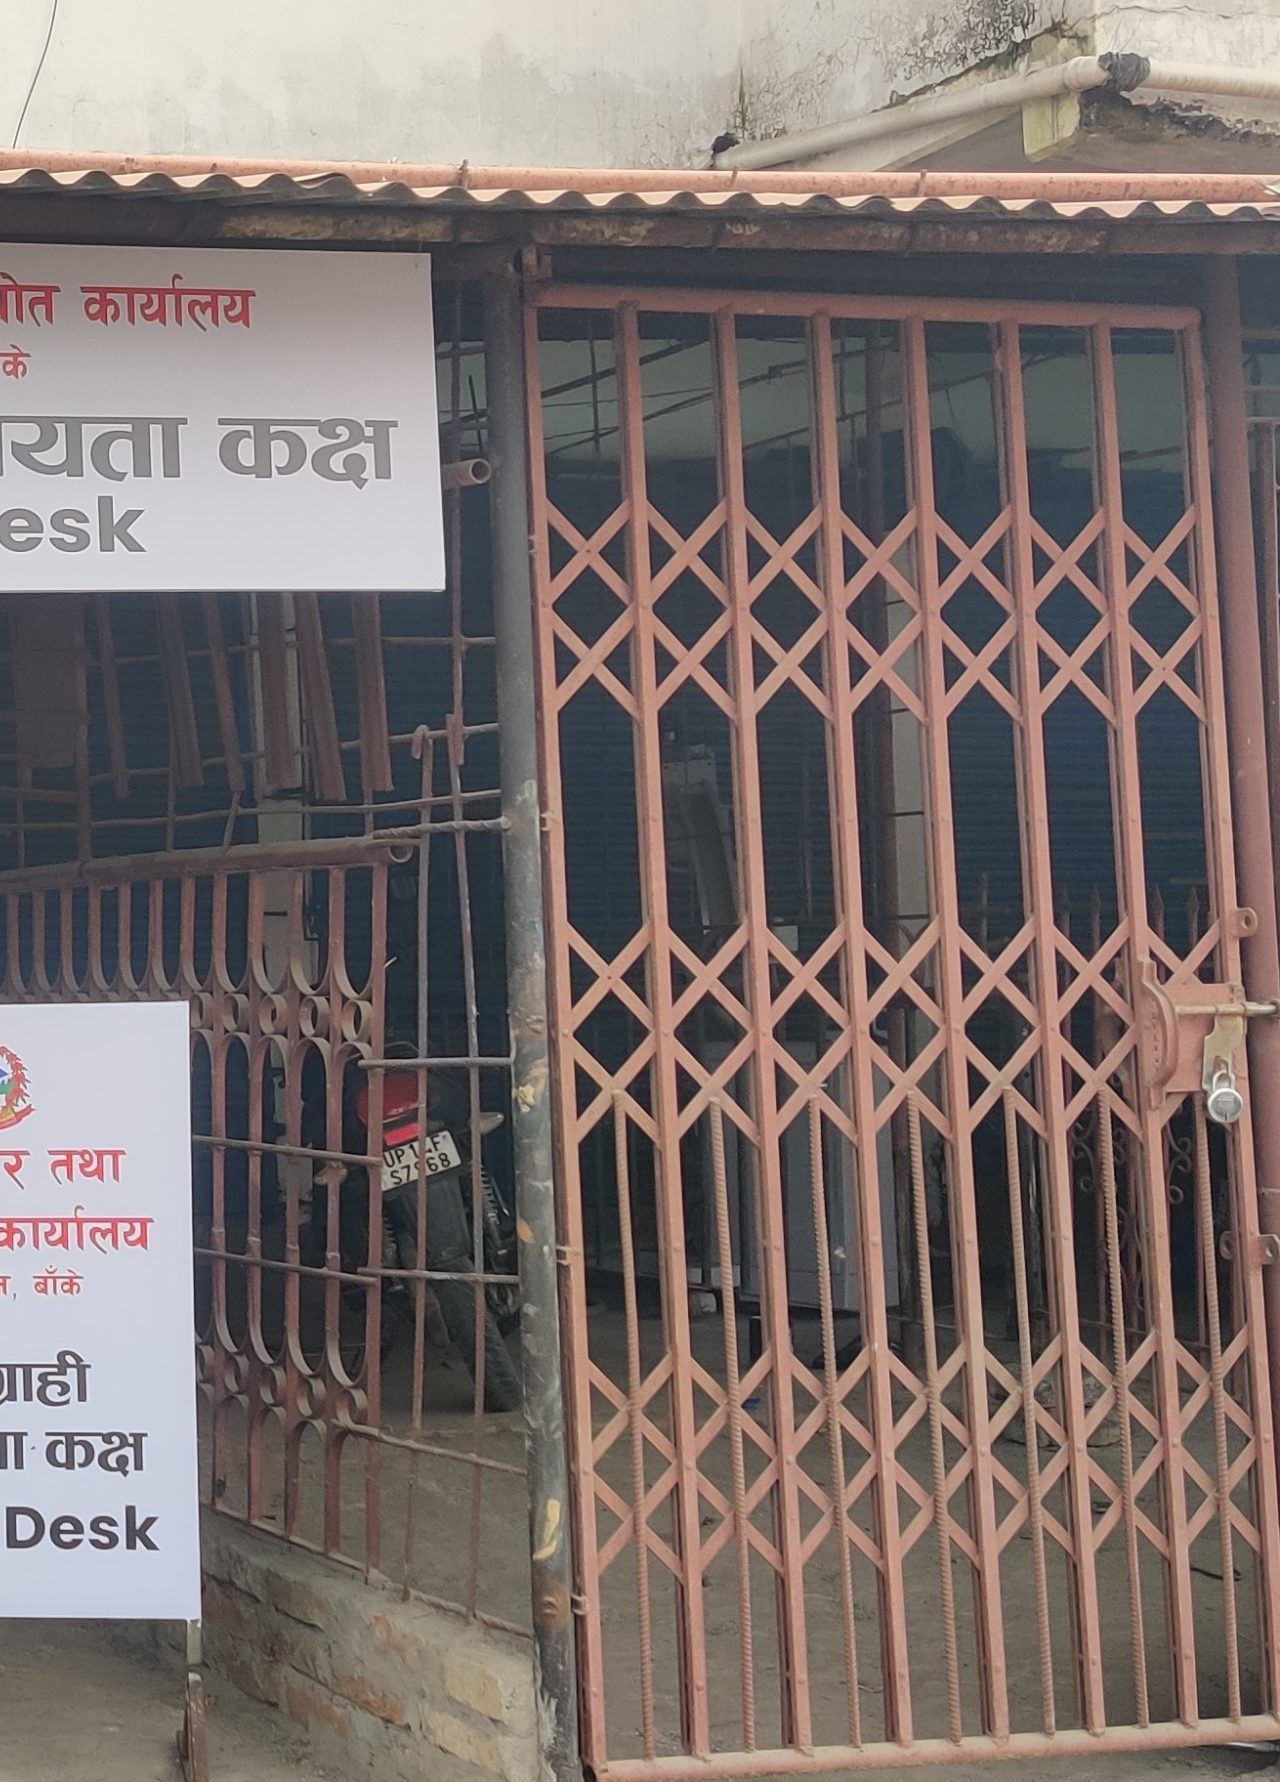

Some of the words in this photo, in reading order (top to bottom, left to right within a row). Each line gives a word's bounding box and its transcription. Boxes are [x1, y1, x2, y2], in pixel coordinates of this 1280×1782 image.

[80, 273, 256, 331] कार्यालय
[218, 416, 399, 490] कक्ष
[48, 1149, 126, 1186] तथा
[33, 1264, 84, 1298] बाँके
[45, 1430, 148, 1478] कक्ष
